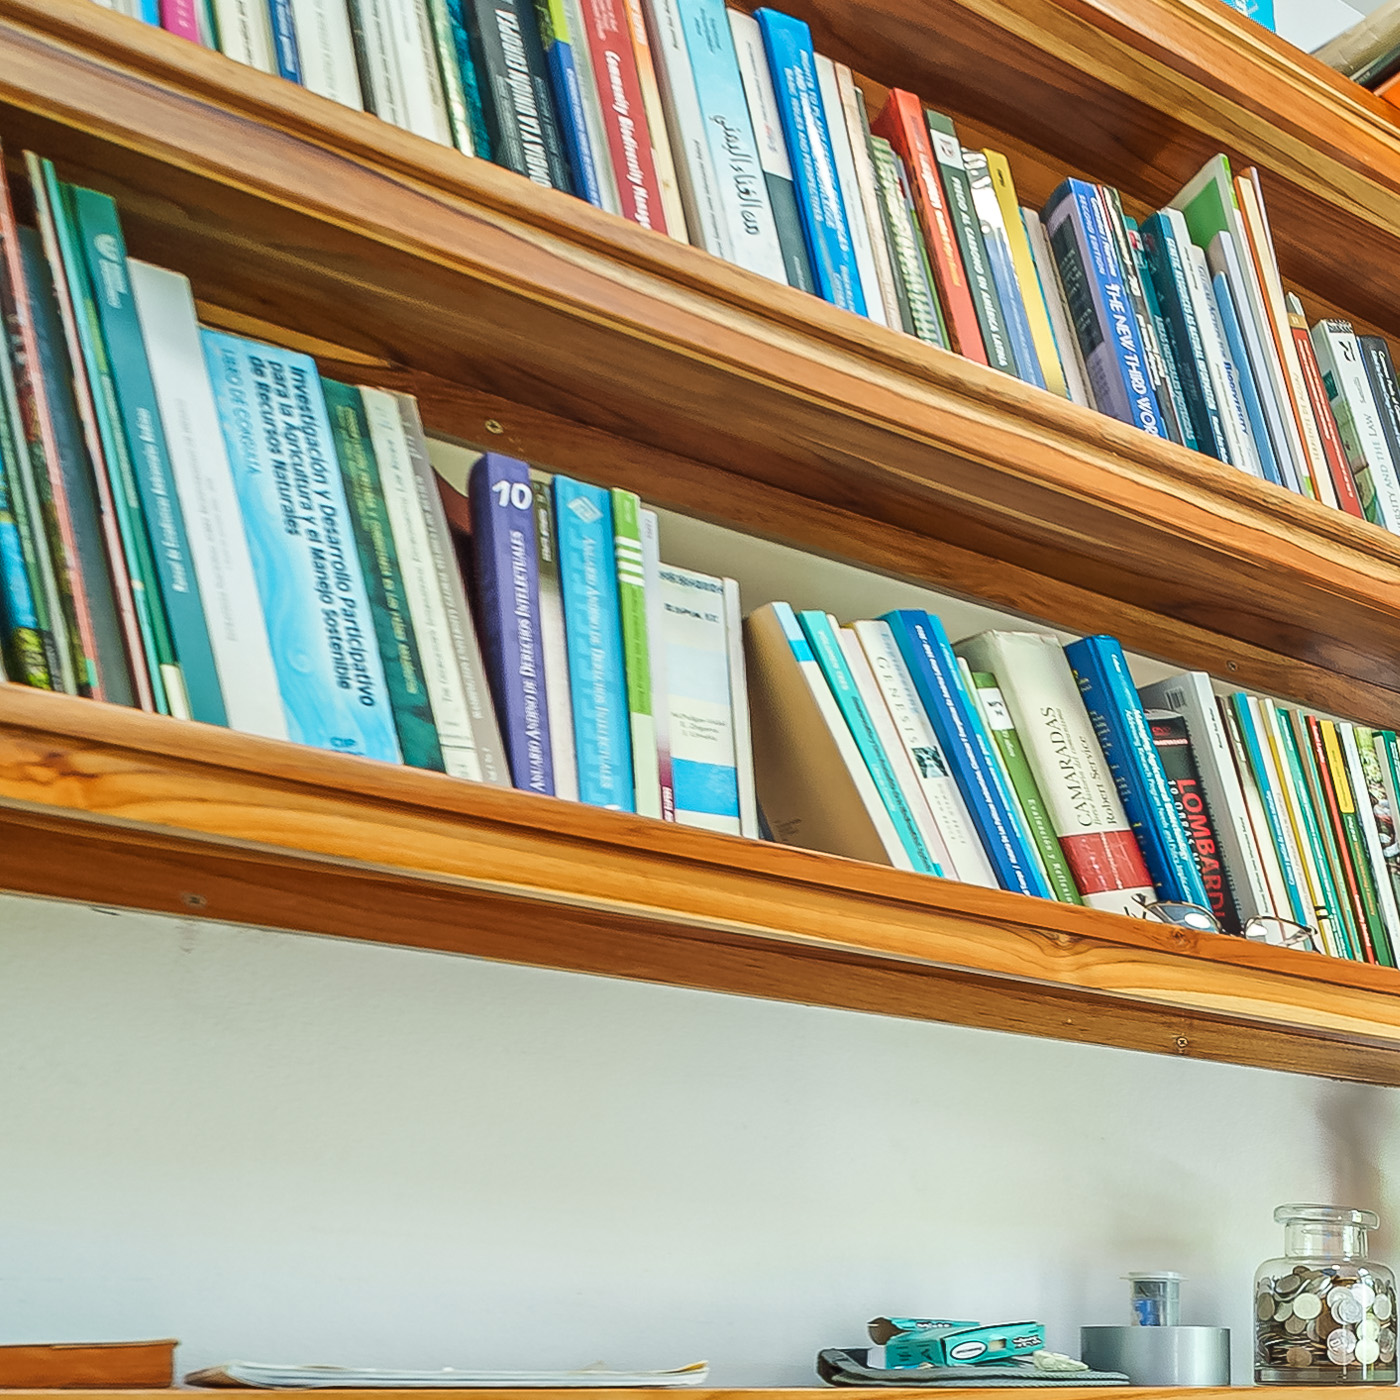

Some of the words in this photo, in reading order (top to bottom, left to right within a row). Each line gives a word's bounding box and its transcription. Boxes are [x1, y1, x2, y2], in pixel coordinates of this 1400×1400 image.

[493, 6, 529, 73] EUROPEA
[502, 65, 536, 118] UNIÓN
[599, 47, 635, 118] Community
[514, 110, 541, 135] LA
[519, 130, 544, 147] Y
[614, 112, 650, 188] Biodiversity
[725, 162, 770, 217] الغناء
[737, 207, 764, 239] من
[959, 210, 971, 226] AL
[1078, 193, 1096, 235] SECOND
[1089, 234, 1106, 275] EDITION
[962, 225, 984, 276] CARBONO
[1165, 235, 1182, 270] GENETIC
[975, 274, 987, 291] EN
[1100, 279, 1126, 316] THE
[1173, 268, 1193, 314] RESOURCES
[1196, 264, 1214, 302] GLOBAL
[979, 290, 1001, 335] AMÉRICA
[1109, 311, 1137, 353] NEW
[1185, 313, 1196, 325] AS
[1207, 303, 1224, 340] ACTION
[990, 332, 1007, 369] LATINA
[1188, 324, 1204, 360] NATURAL
[1216, 339, 1229, 361] FOR
[248, 354, 268, 378] de
[267, 359, 291, 398] para
[1120, 347, 1151, 399] THIRD
[1196, 358, 1217, 411] INFORMATION
[1376, 349, 1391, 379] Common
[1385, 378, 1396, 397] Pools
[228, 387, 248, 405] DE
[278, 401, 299, 417] la
[1160, 342, 1183, 392] NATURALES
[1173, 389, 1196, 442] PROTEGIDAS
[1222, 359, 1249, 435] BIODIVERSITY
[253, 380, 284, 456] Recursos
[287, 364, 331, 484] Investigación
[1362, 412, 1378, 438] LAW
[280, 419, 319, 511] Agricultura
[1370, 438, 1385, 462] THE
[271, 458, 302, 537] Naturales
[313, 489, 330, 499] y
[490, 479, 533, 511] 10
[1378, 462, 1393, 489] AND
[299, 513, 317, 524] y
[305, 527, 325, 543] el
[319, 503, 354, 595] Desarrollo
[507, 527, 530, 617] INTELECTUALES
[305, 544, 337, 603] Manejo
[321, 605, 356, 689] Sostenible
[336, 597, 378, 710] Participativo
[514, 615, 535, 677] DERECHOS
[520, 677, 536, 693] DE
[873, 654, 920, 745] GENESIS
[521, 692, 541, 740] ANDINO
[524, 738, 545, 792] ANUARIO
[1039, 704, 1094, 828] CAMARADAS
[1075, 734, 1101, 781] Service
[1092, 782, 1118, 826] Robert
[1128, 707, 1154, 752] Managing
[1145, 752, 1171, 803] Agricultural
[1160, 801, 1191, 862] Biotechnology
[1166, 778, 1180, 796] 10
[1025, 797, 1055, 852] Evaluación
[1174, 775, 1233, 919] LOMBARDI
